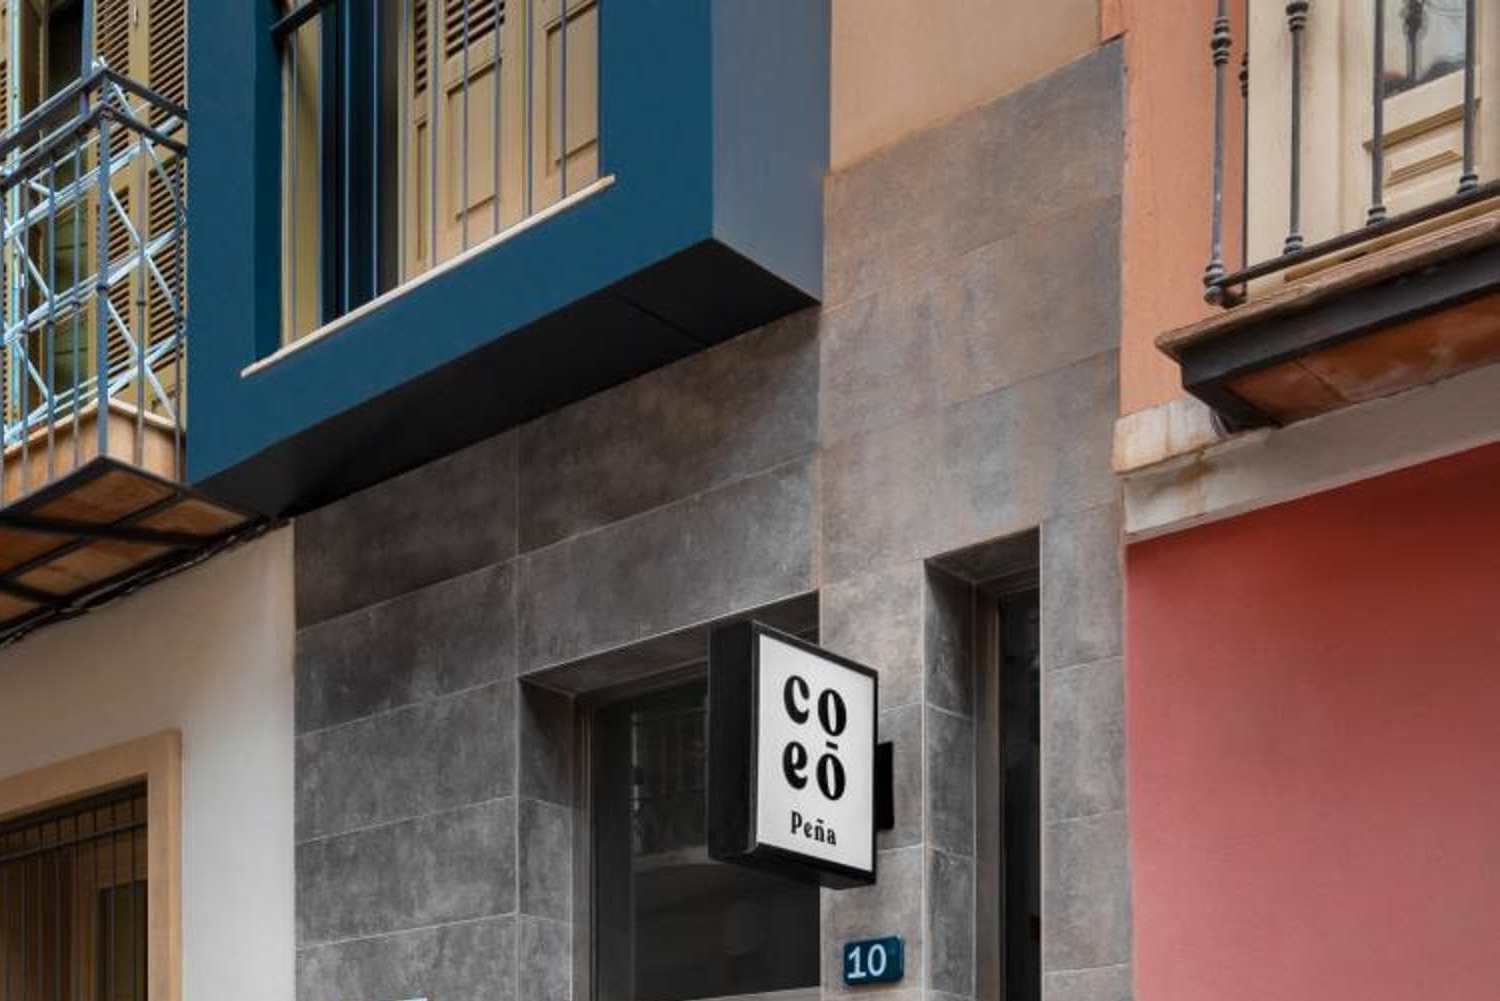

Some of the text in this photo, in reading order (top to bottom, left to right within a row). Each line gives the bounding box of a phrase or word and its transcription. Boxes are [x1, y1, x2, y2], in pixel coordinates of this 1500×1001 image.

[783, 674, 848, 737] co
[789, 808, 838, 846] Peña
[847, 943, 887, 980] 10
